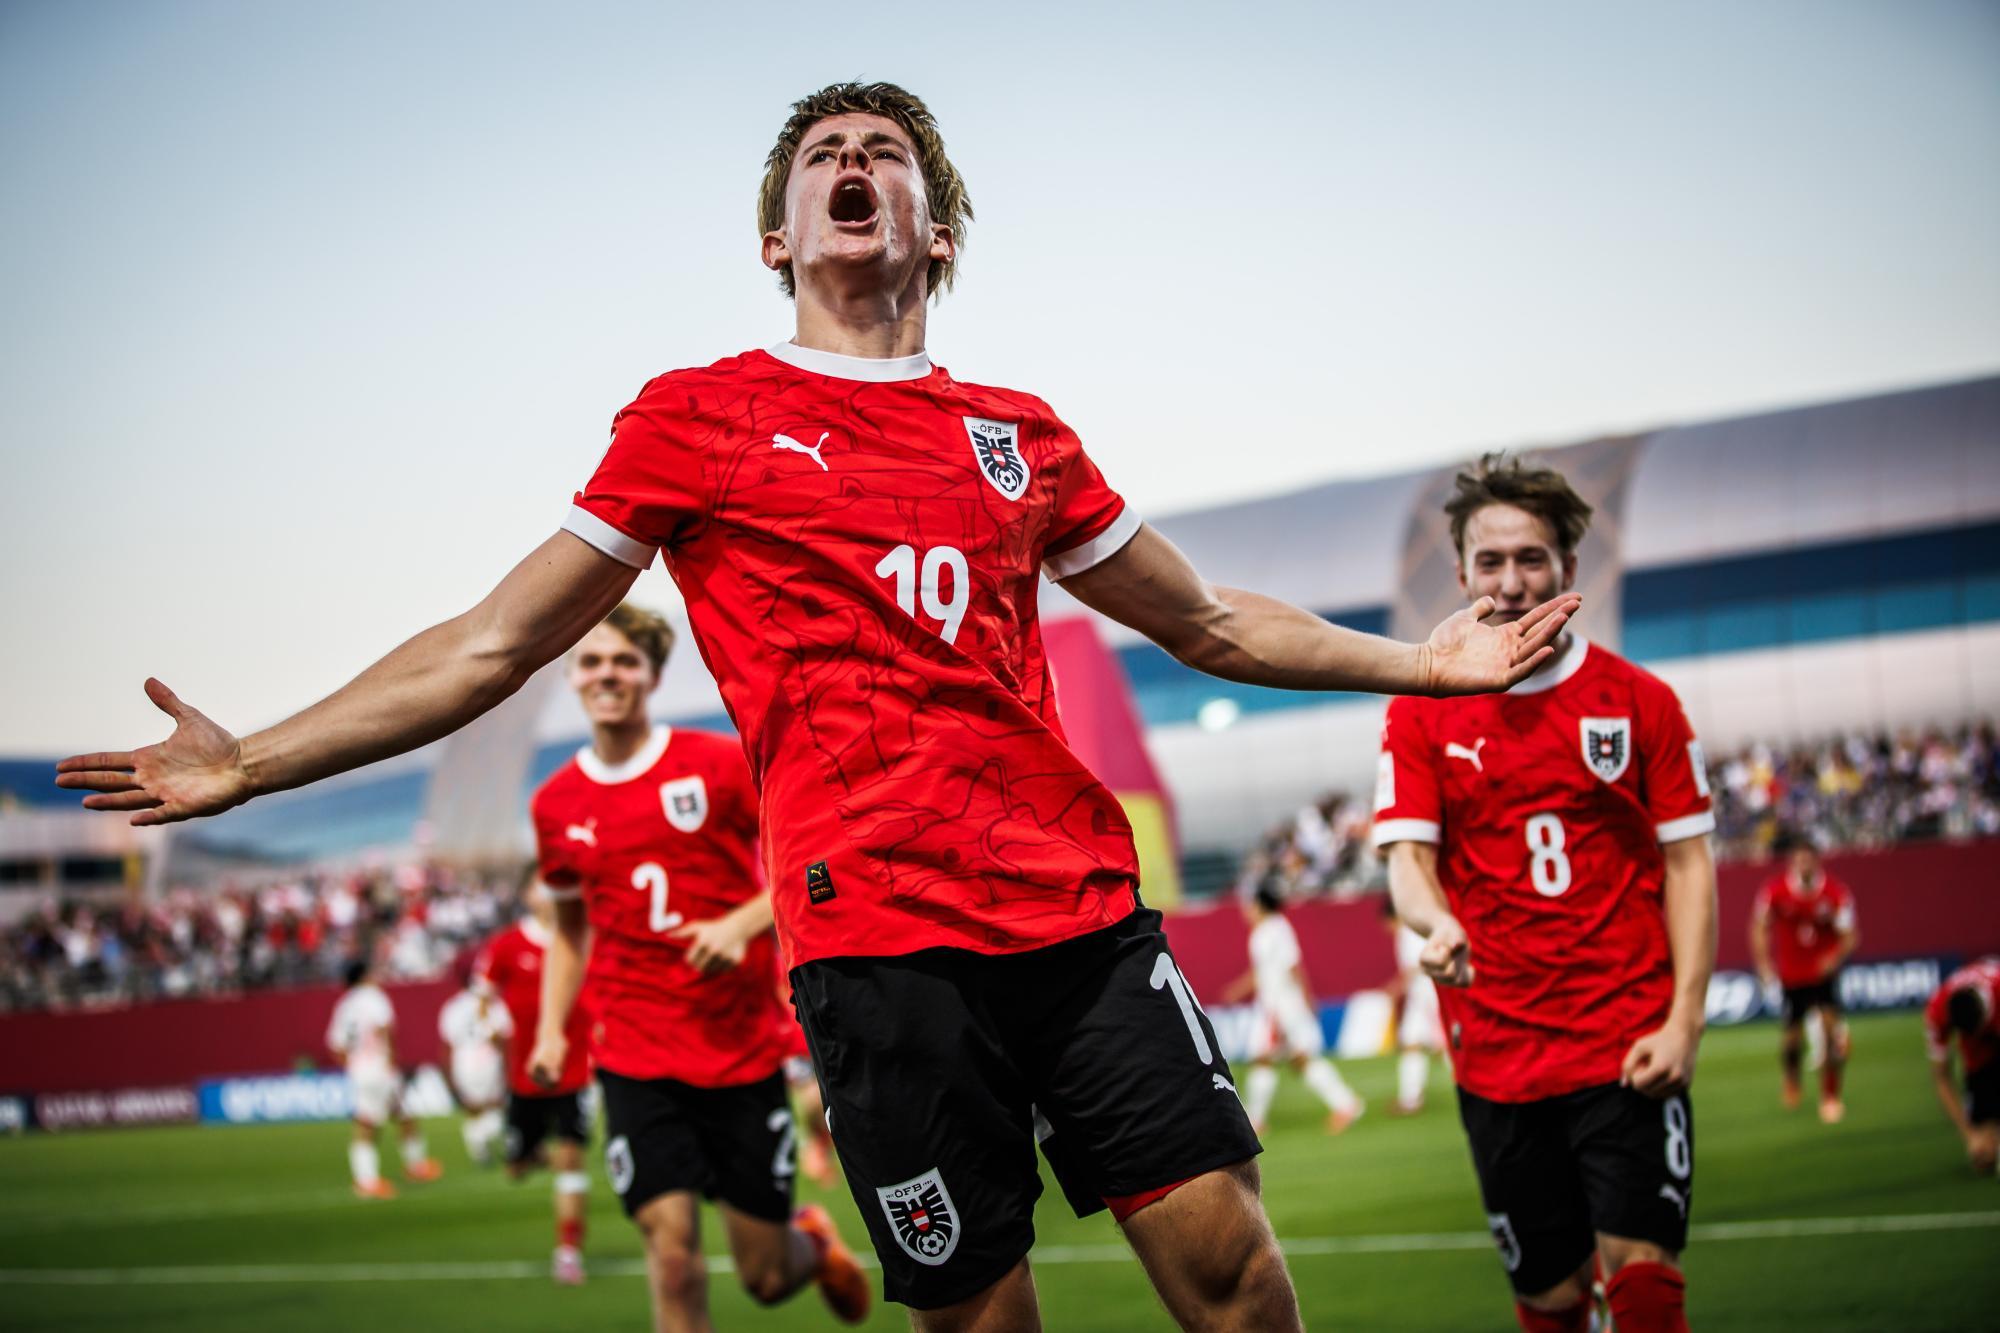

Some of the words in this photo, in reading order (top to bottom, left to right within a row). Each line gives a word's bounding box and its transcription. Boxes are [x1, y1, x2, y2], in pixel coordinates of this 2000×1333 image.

[980, 424, 1002, 435] ÖFB
[875, 544, 970, 646] 19
[1525, 812, 1572, 897] 8
[630, 862, 684, 933] 2
[1150, 952, 1213, 1065] 1
[767, 1108, 797, 1178] 2
[1663, 1096, 1690, 1180] 8
[894, 1183, 923, 1199] ÖFB
